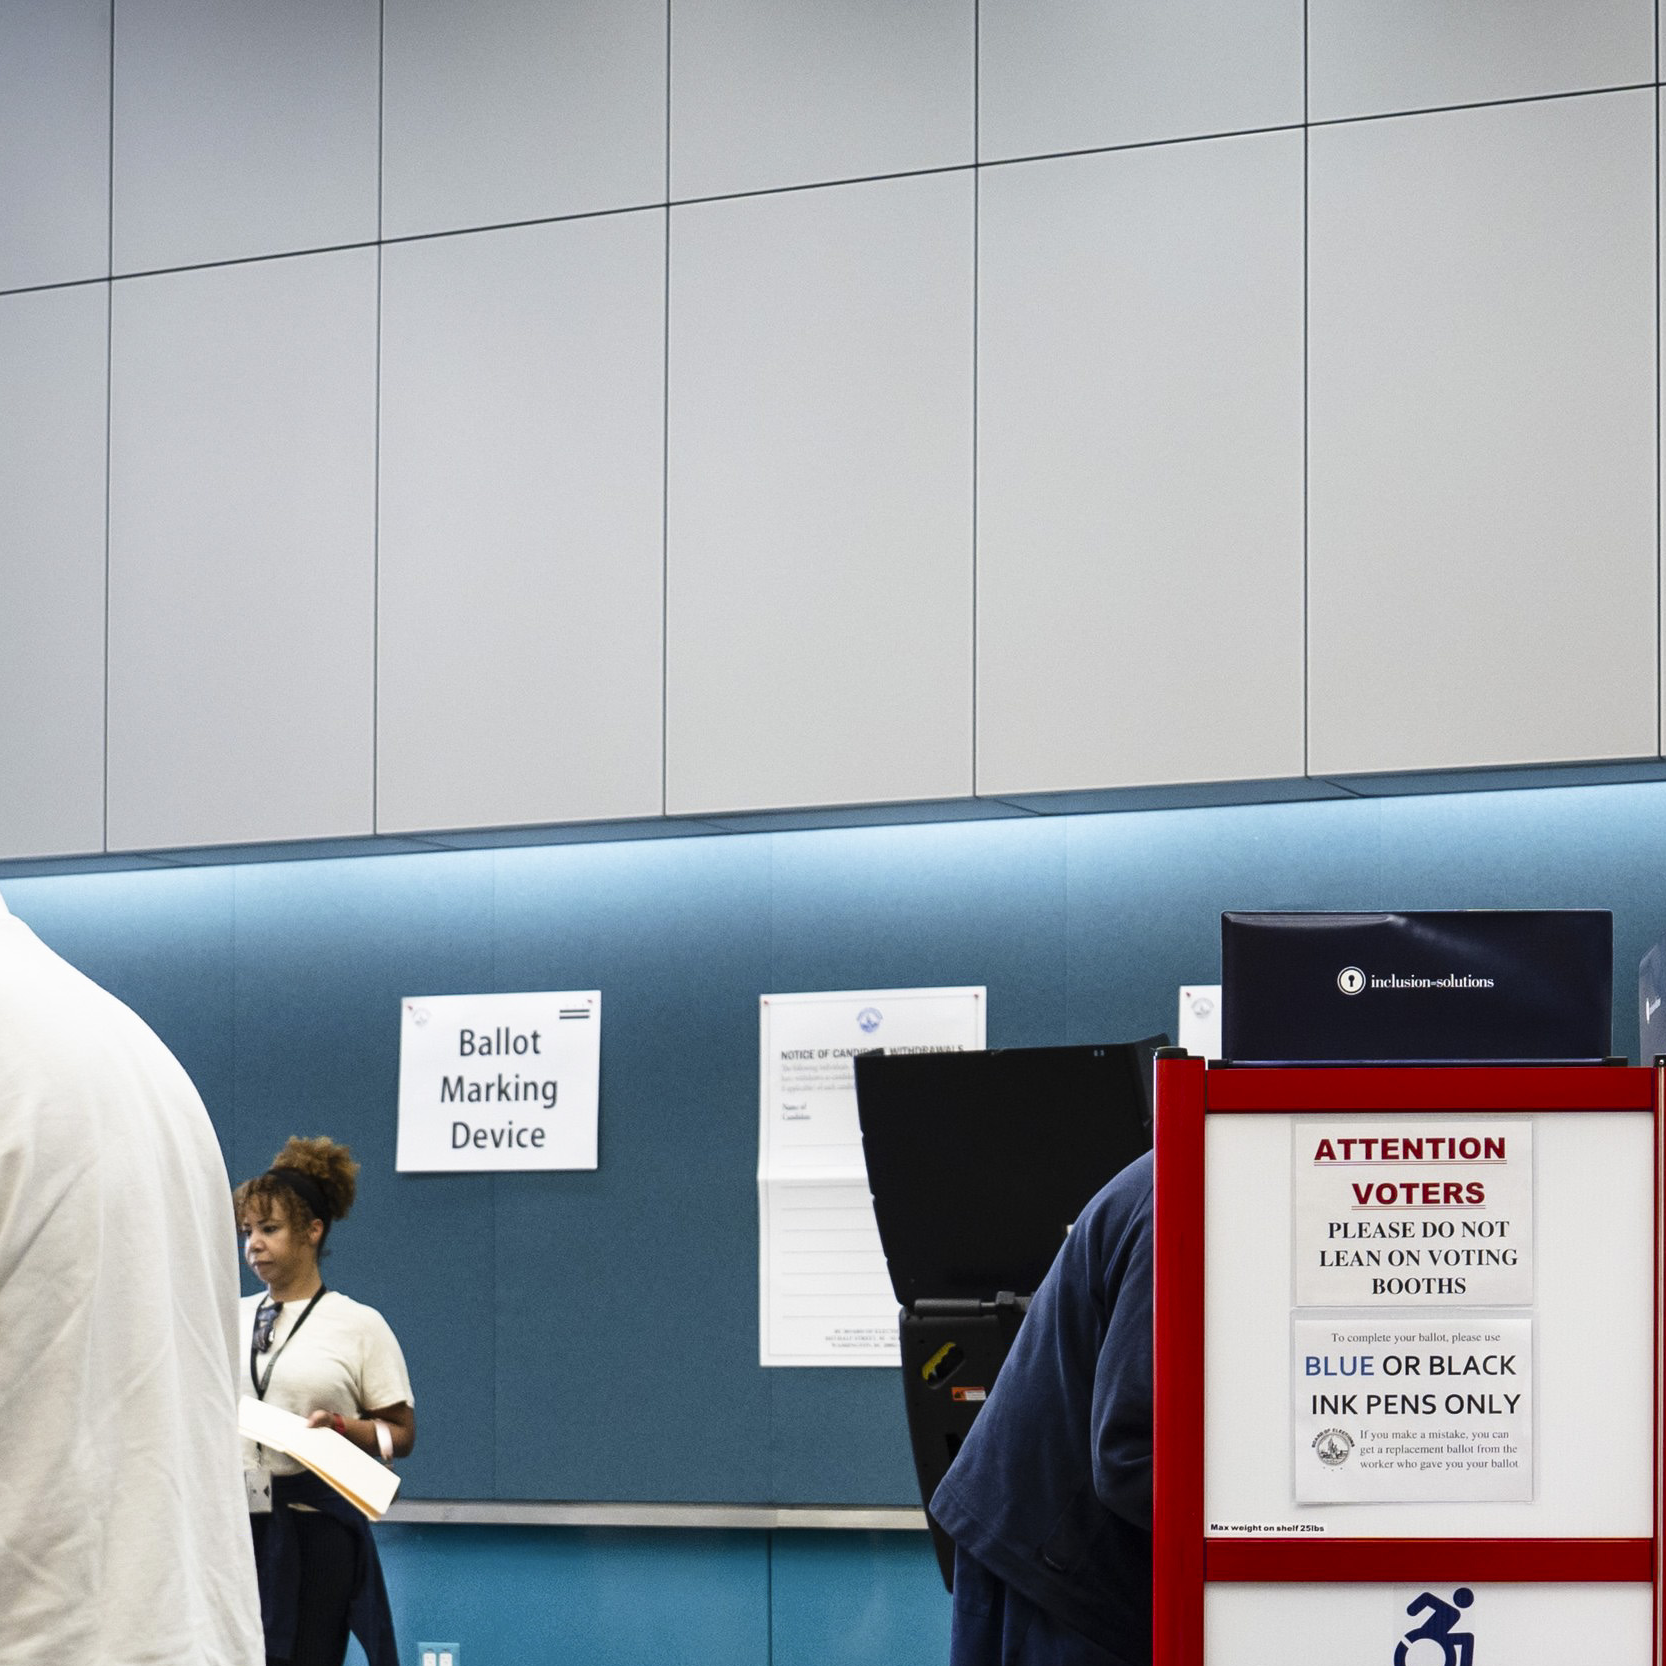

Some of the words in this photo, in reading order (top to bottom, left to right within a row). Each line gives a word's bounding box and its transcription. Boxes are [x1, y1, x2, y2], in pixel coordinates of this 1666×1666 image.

[459, 1026, 541, 1057] Ballot
[780, 1048, 815, 1061] NOTICE
[817, 1048, 830, 1060] OF
[440, 1073, 558, 1110] Marking
[451, 1120, 546, 1150] Device
[1313, 1136, 1506, 1161] ATTENTION
[1351, 1181, 1485, 1204] VOTERS
[1328, 1221, 1416, 1239] PLEASE
[1421, 1221, 1455, 1239] DO
[1461, 1220, 1510, 1238] NOT
[1319, 1249, 1381, 1267] LEAN
[1387, 1249, 1421, 1267] ON
[1427, 1248, 1518, 1267] VOTING
[1372, 1277, 1467, 1295] BOOTHS
[1330, 1332, 1345, 1343] To
[1346, 1332, 1392, 1345] complete
[1393, 1334, 1417, 1345] your
[1418, 1332, 1450, 1343] ballot,
[1451, 1332, 1482, 1345] please
[1484, 1334, 1501, 1342] use
[1305, 1355, 1375, 1377] BLUE
[1382, 1355, 1421, 1377] OR
[1429, 1354, 1517, 1376] BLACK
[1312, 1394, 1359, 1415] INK
[1366, 1393, 1437, 1415] PENS
[1444, 1393, 1521, 1415] ONLY
[1360, 1429, 1369, 1440] If
[1370, 1432, 1389, 1442] you
[1391, 1429, 1418, 1440] make
[1428, 1429, 1469, 1440] mistake,
[1471, 1431, 1490, 1442] you
[1491, 1431, 1510, 1439] can
[1359, 1446, 1375, 1457] get
[1385, 1444, 1444, 1457] replacement
[1446, 1443, 1474, 1454] ballot
[1477, 1443, 1501, 1454] from
[1502, 1443, 1518, 1454] the
[1359, 1459, 1395, 1469] worker
[1396, 1458, 1418, 1469] who
[1419, 1461, 1443, 1471] gave
[1445, 1461, 1464, 1471] you
[1465, 1461, 1489, 1471] your
[1490, 1458, 1519, 1469] ballot
[1210, 1523, 1230, 1531] Max
[1230, 1524, 1262, 1533] weight
[1276, 1524, 1299, 1532] shelf
[1299, 1524, 1325, 1532] 25lbs
